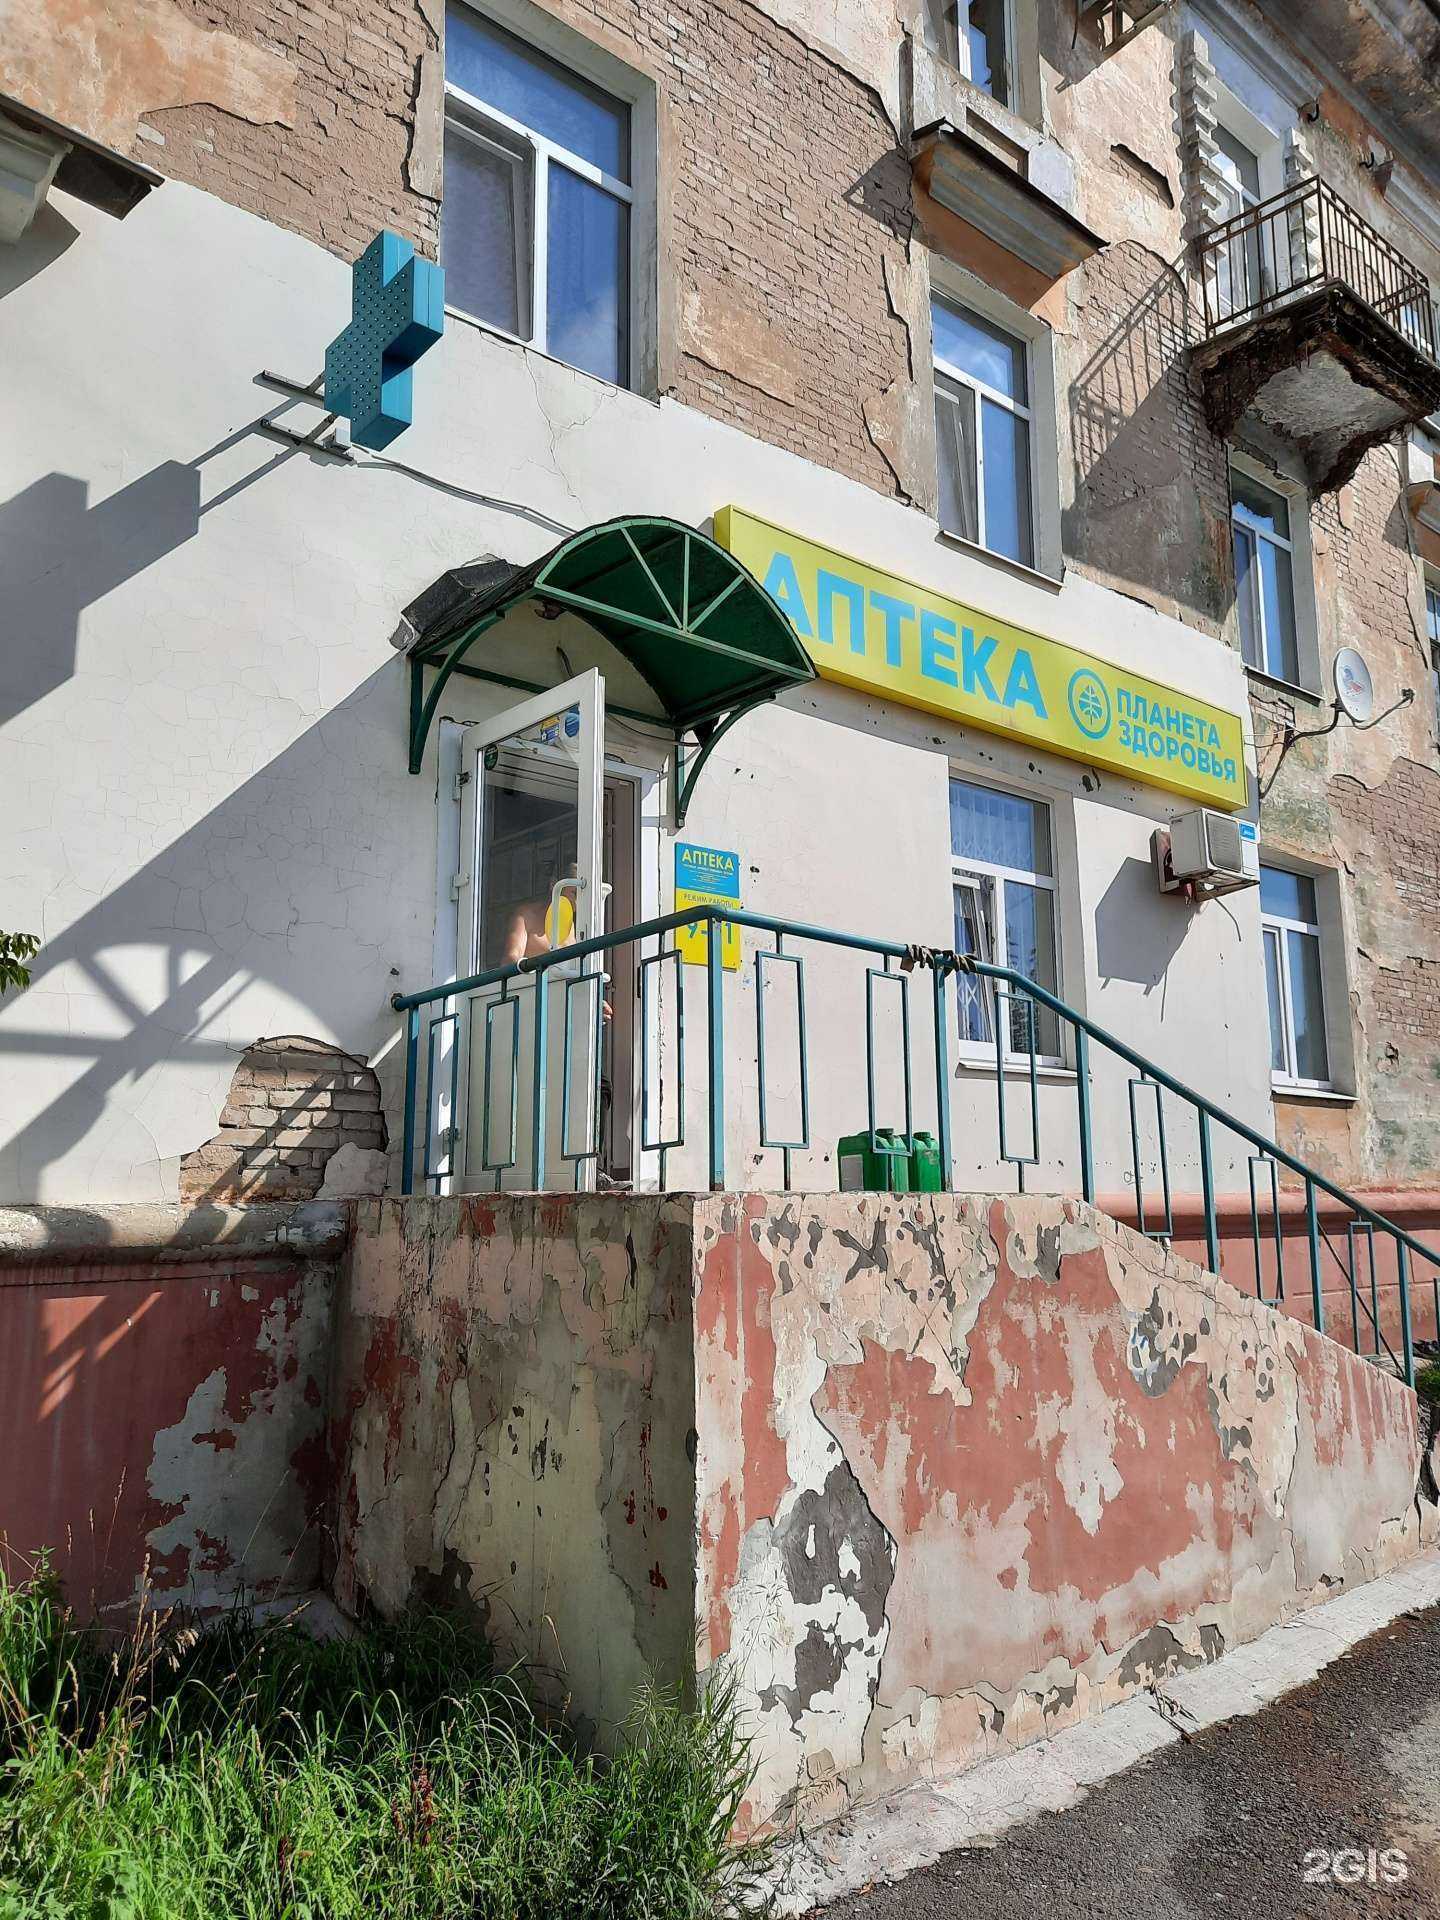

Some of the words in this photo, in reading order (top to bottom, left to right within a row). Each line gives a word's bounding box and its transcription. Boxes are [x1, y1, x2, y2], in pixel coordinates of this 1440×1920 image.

[762, 551, 1048, 720] АПТЕКА
[1117, 687, 1221, 749] ПЛАНЕТА
[1119, 719, 1236, 783] ЗДОРОВЬЯ
[682, 848, 734, 871] АПТЕКА
